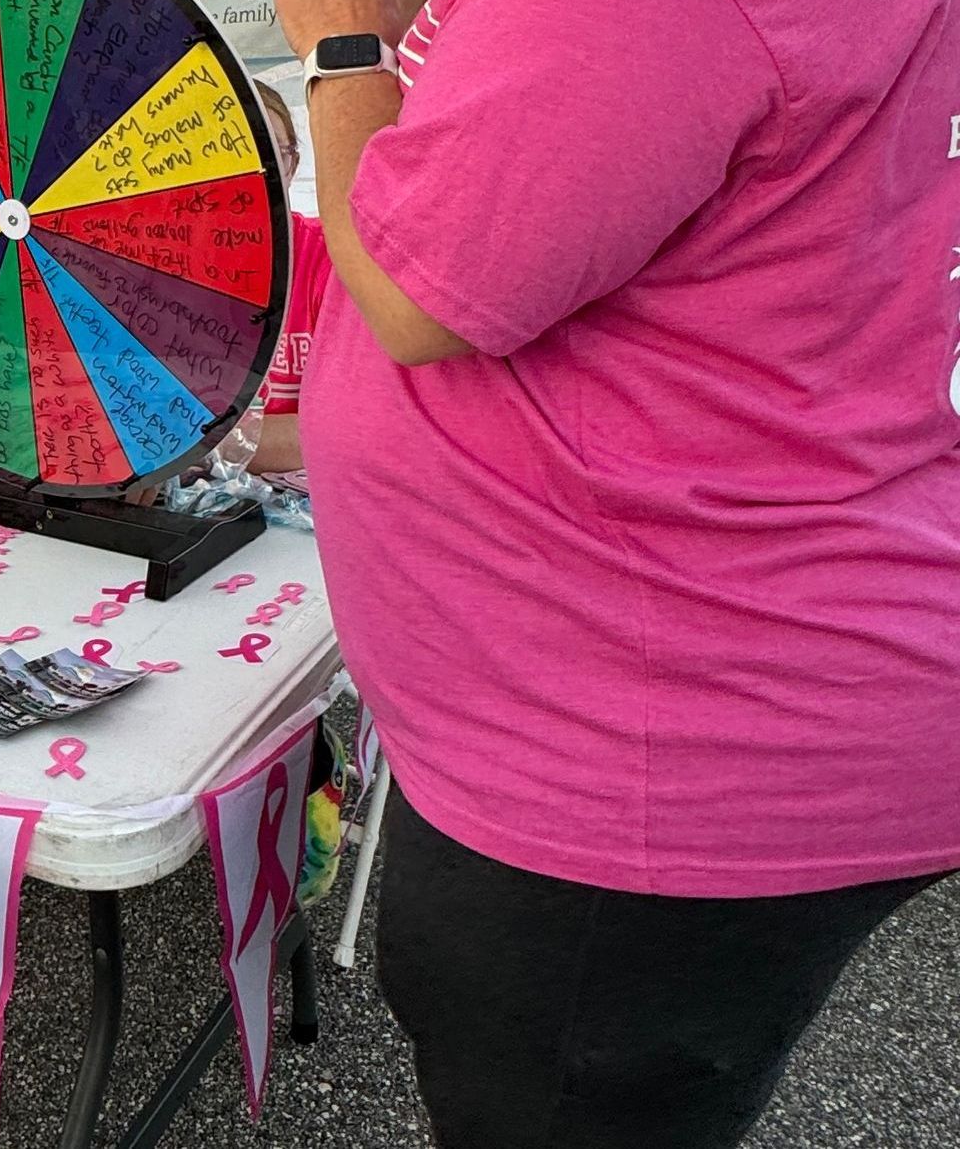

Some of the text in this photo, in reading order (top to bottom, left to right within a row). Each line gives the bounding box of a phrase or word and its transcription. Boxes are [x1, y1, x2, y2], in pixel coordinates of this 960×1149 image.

[222, 2, 276, 27] family
[35, 25, 65, 95] Candy
[20, 72, 40, 90] by
[106, 121, 252, 202] How many sets
[211, 227, 263, 249] make
[104, 295, 222, 391] What color
[28, 367, 44, 387] no
[172, 397, 205, 431] had
